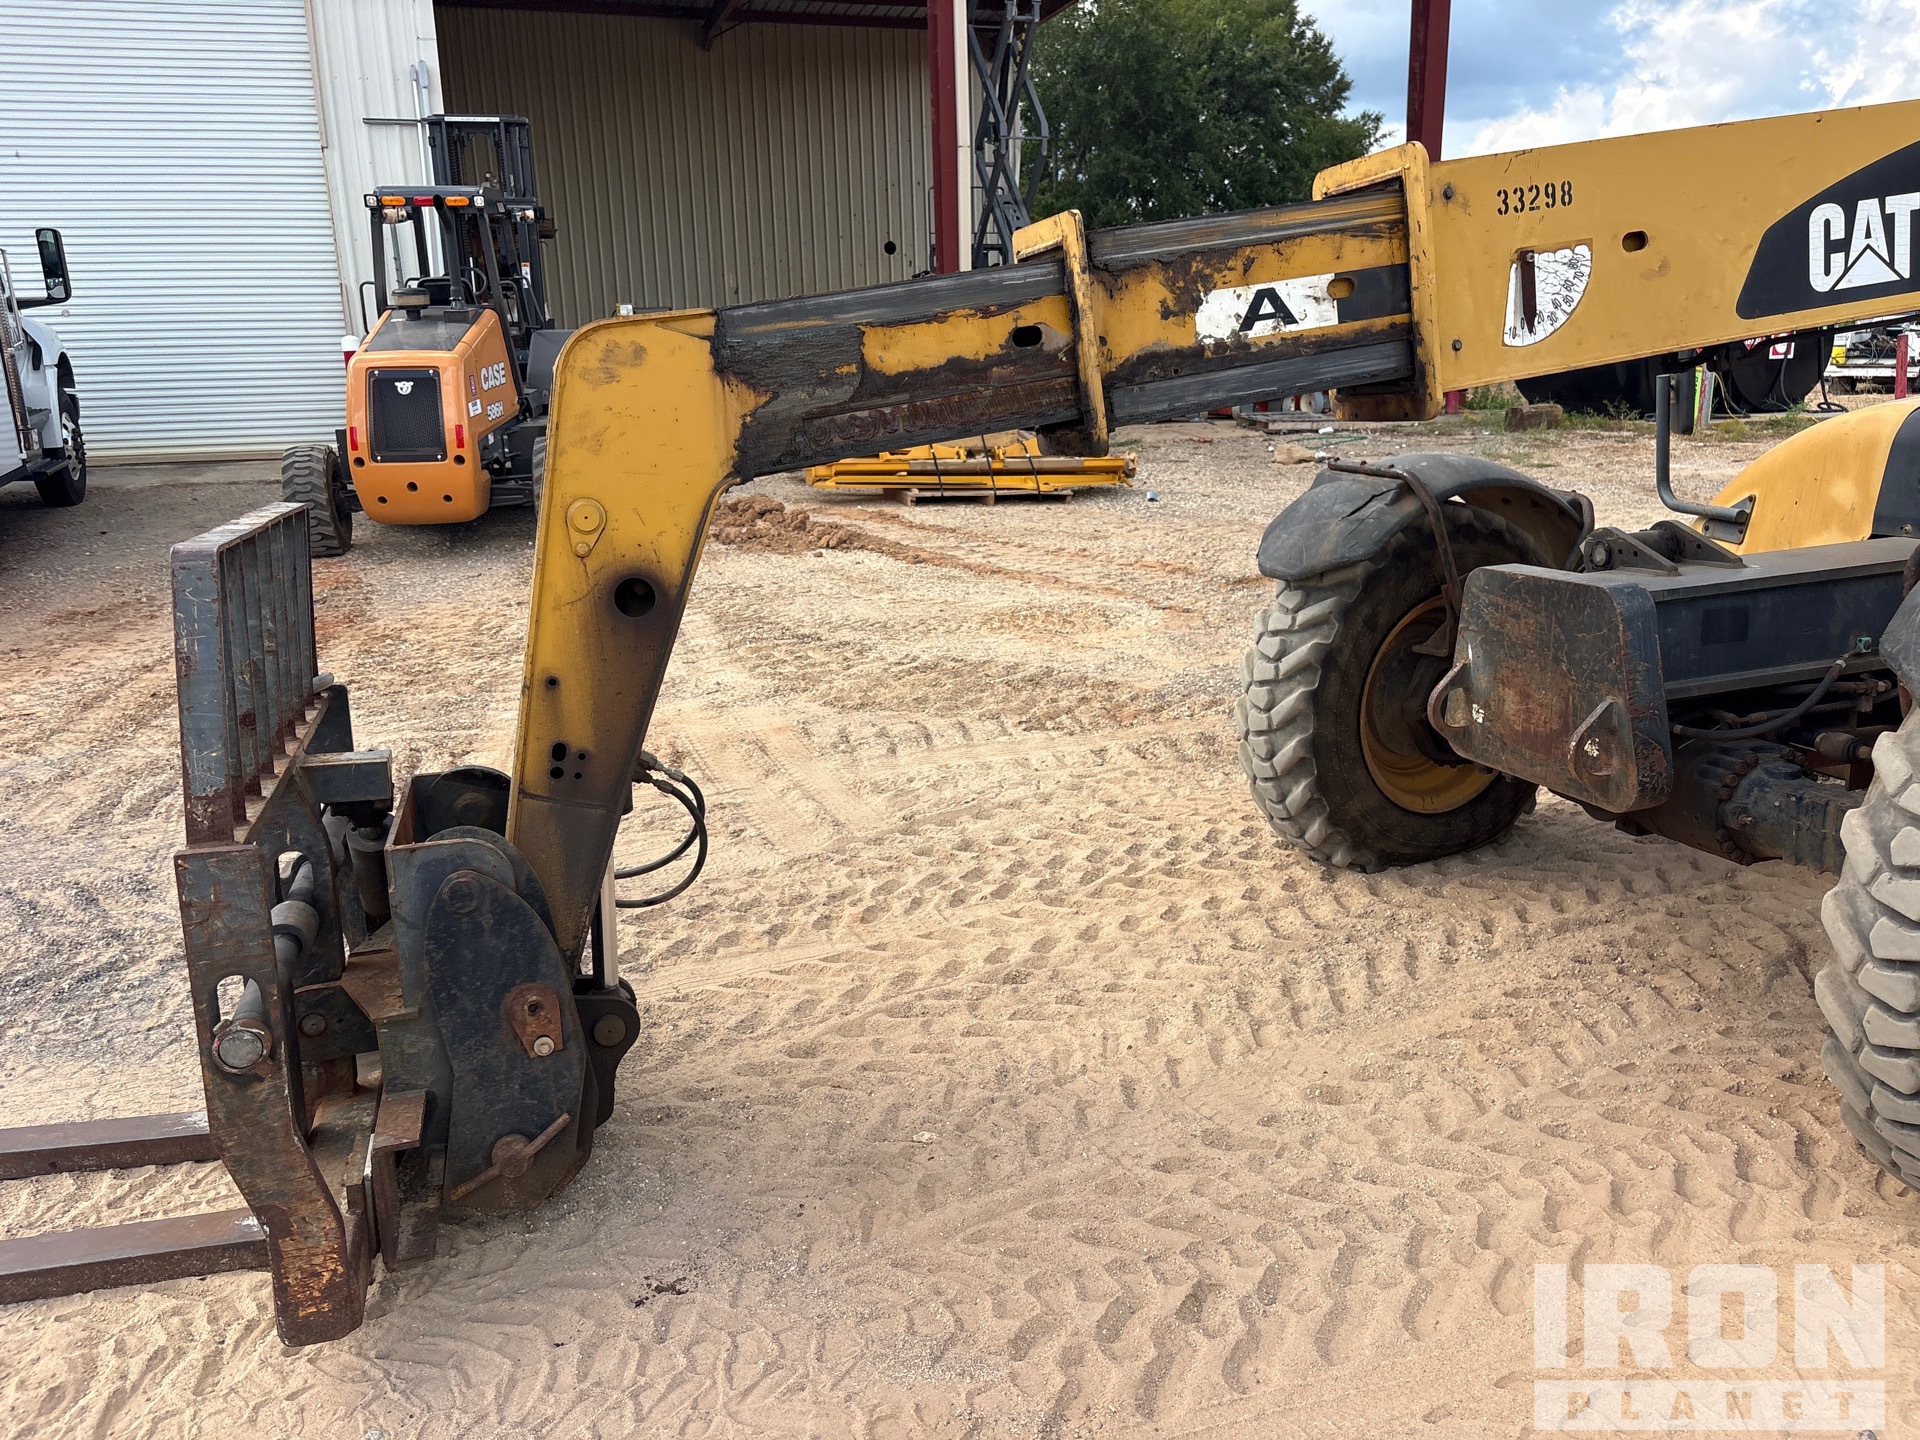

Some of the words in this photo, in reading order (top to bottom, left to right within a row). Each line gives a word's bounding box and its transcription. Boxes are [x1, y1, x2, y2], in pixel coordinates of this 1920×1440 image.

[1496, 180, 1574, 216] 33298
[1809, 192, 1920, 292] CAT
[1567, 258, 1580, 270] 80
[1572, 270, 1585, 284] 70
[1562, 279, 1575, 292] 60
[1551, 297, 1563, 311] 40
[1562, 294, 1575, 308] 50
[1238, 287, 1300, 333] A
[1536, 310, 1545, 325] 20
[1546, 310, 1559, 326] 30
[481, 361, 507, 391] CASE
